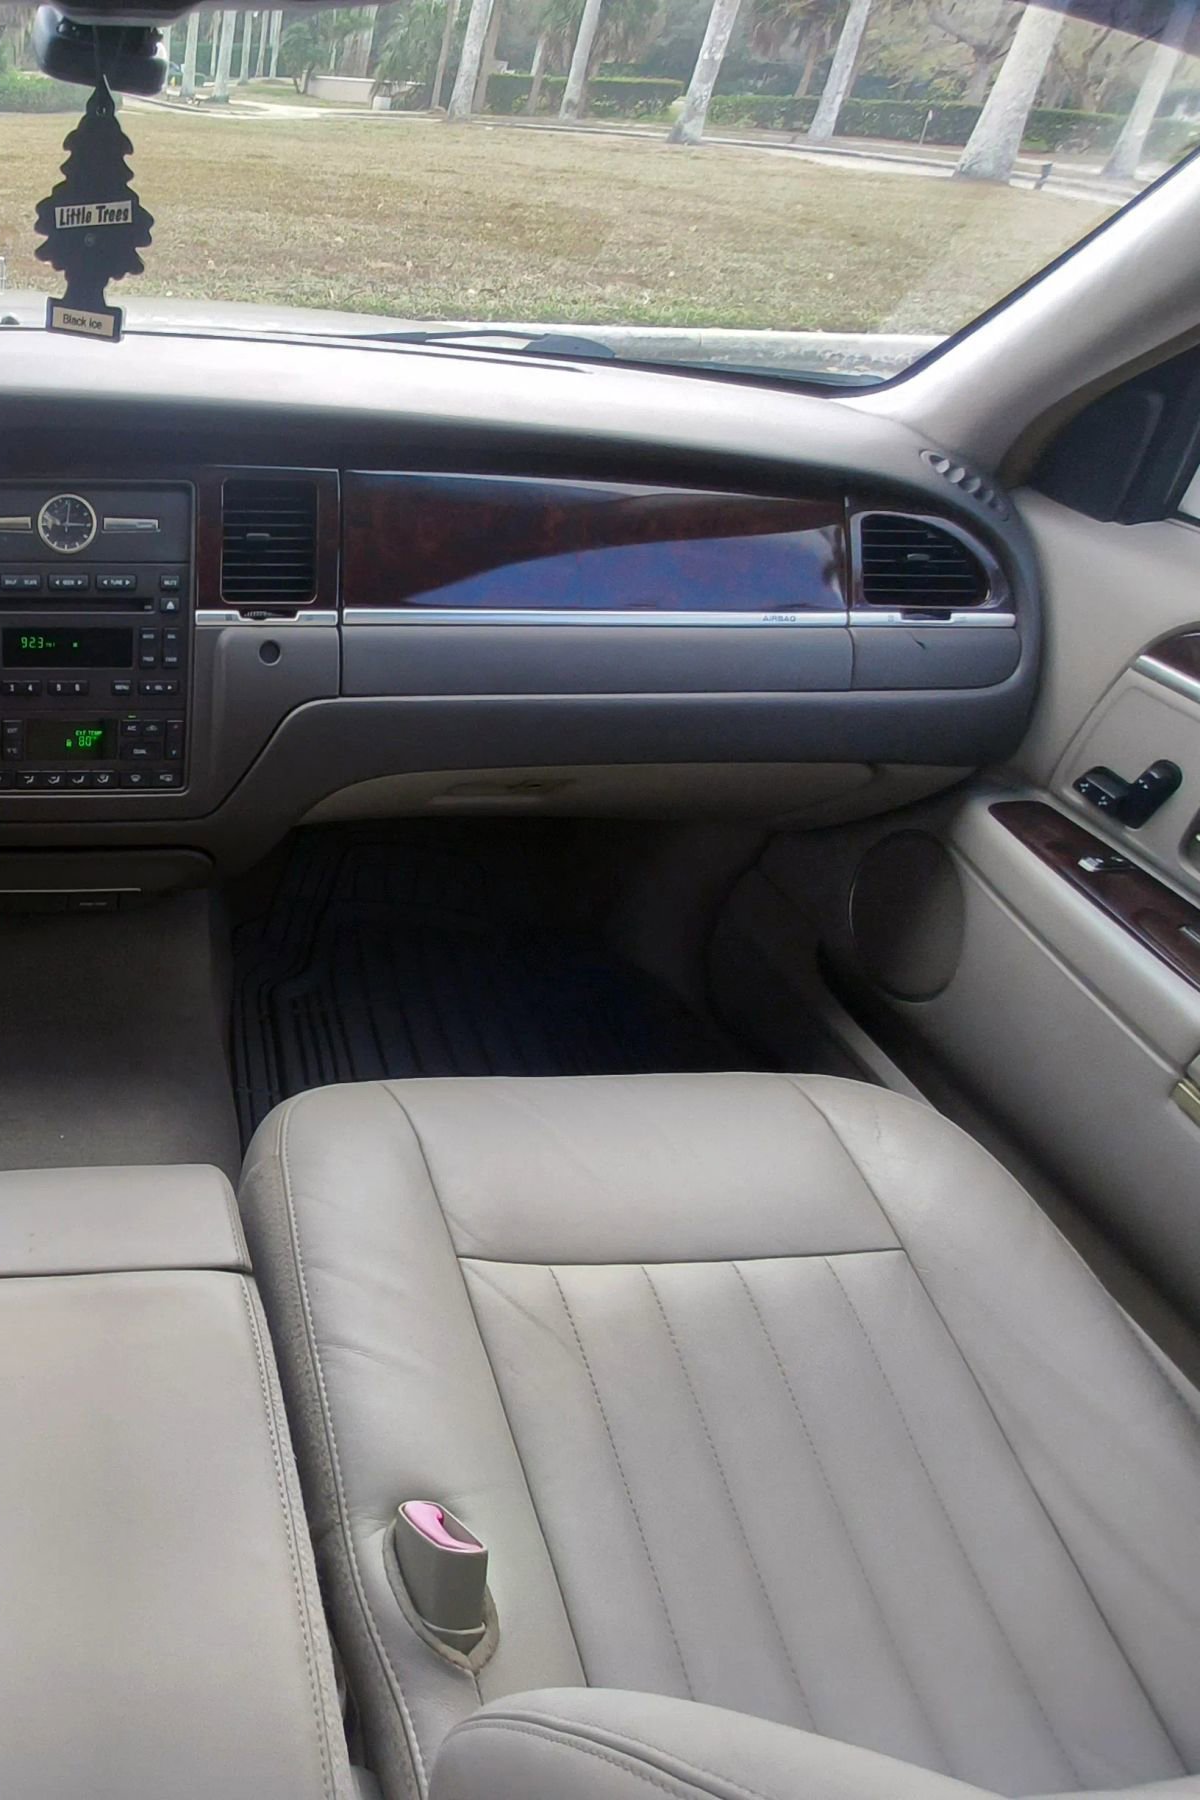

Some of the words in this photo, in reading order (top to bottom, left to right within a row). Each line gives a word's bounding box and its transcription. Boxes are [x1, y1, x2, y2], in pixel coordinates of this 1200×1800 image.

[59, 206, 92, 226] Little
[95, 205, 129, 222] Trees
[62, 313, 87, 328] Black
[89, 318, 103, 330] Ice
